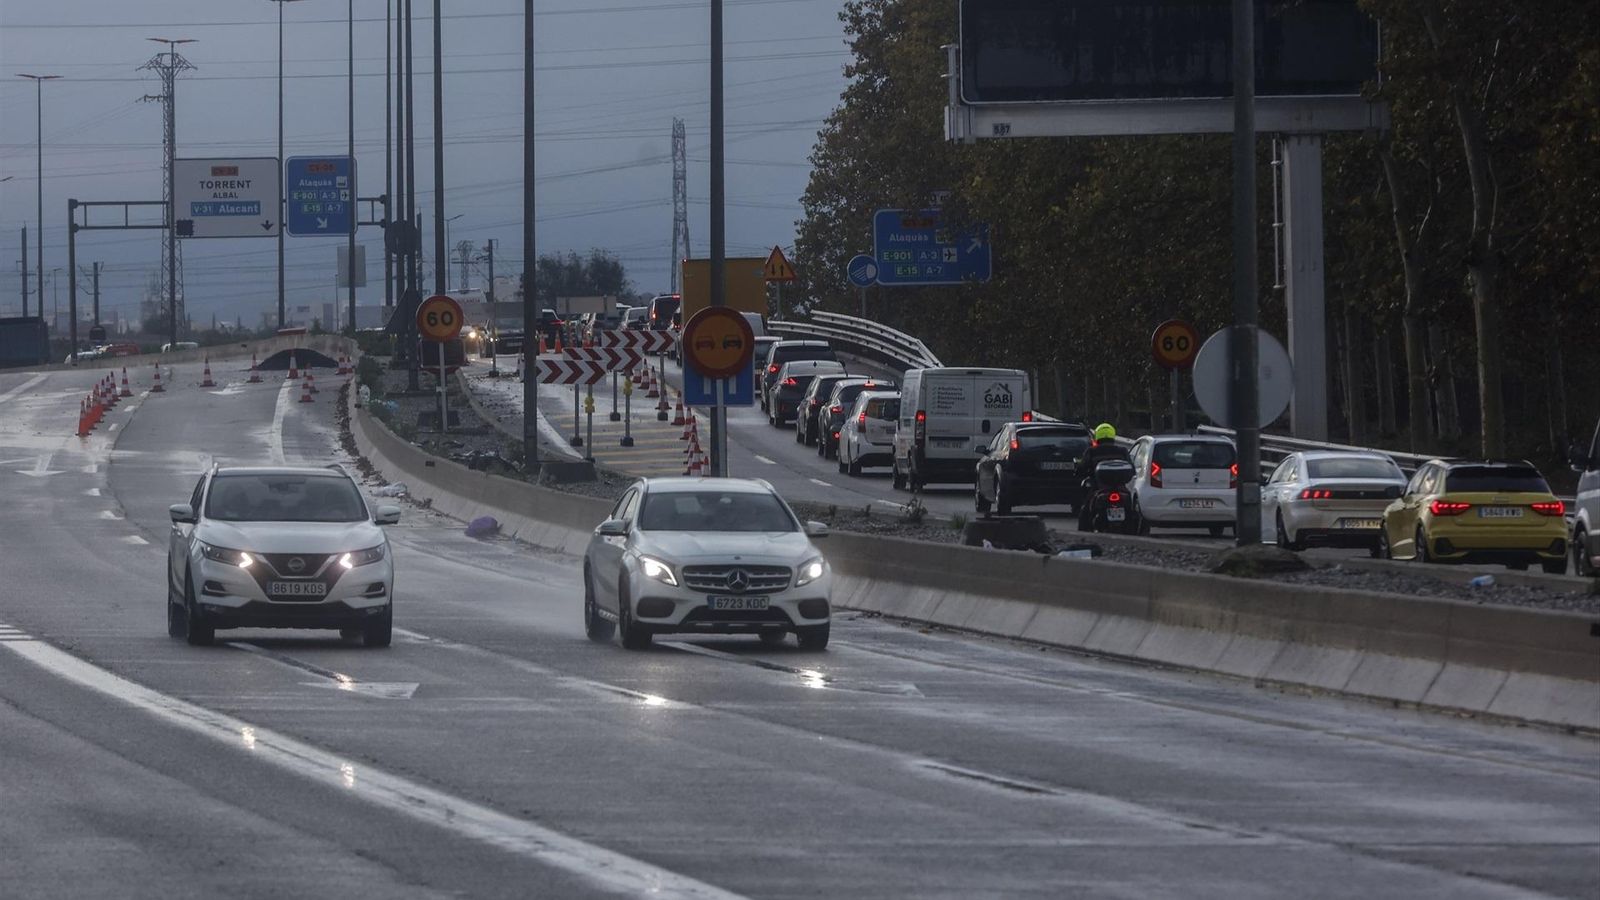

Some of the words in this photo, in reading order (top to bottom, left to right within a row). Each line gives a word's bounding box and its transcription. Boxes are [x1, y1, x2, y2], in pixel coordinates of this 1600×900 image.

[200, 180, 252, 189] TORRENT
[293, 191, 317, 199] E-901
[322, 191, 336, 199] A-3
[194, 205, 212, 213] V-31
[219, 204, 259, 213] Alacant
[304, 204, 321, 212] E-15
[328, 204, 341, 212] A-7
[883, 251, 911, 260] E-901
[920, 251, 937, 260] A-3
[896, 266, 918, 274] E-15
[926, 266, 943, 274] A-7
[427, 311, 454, 327] 60
[1163, 335, 1190, 352] 60
[984, 394, 1013, 404] GABI
[273, 583, 301, 594] 8619
[303, 583, 325, 594] KDS
[716, 598, 744, 609] 6723
[746, 598, 767, 609] KDC
